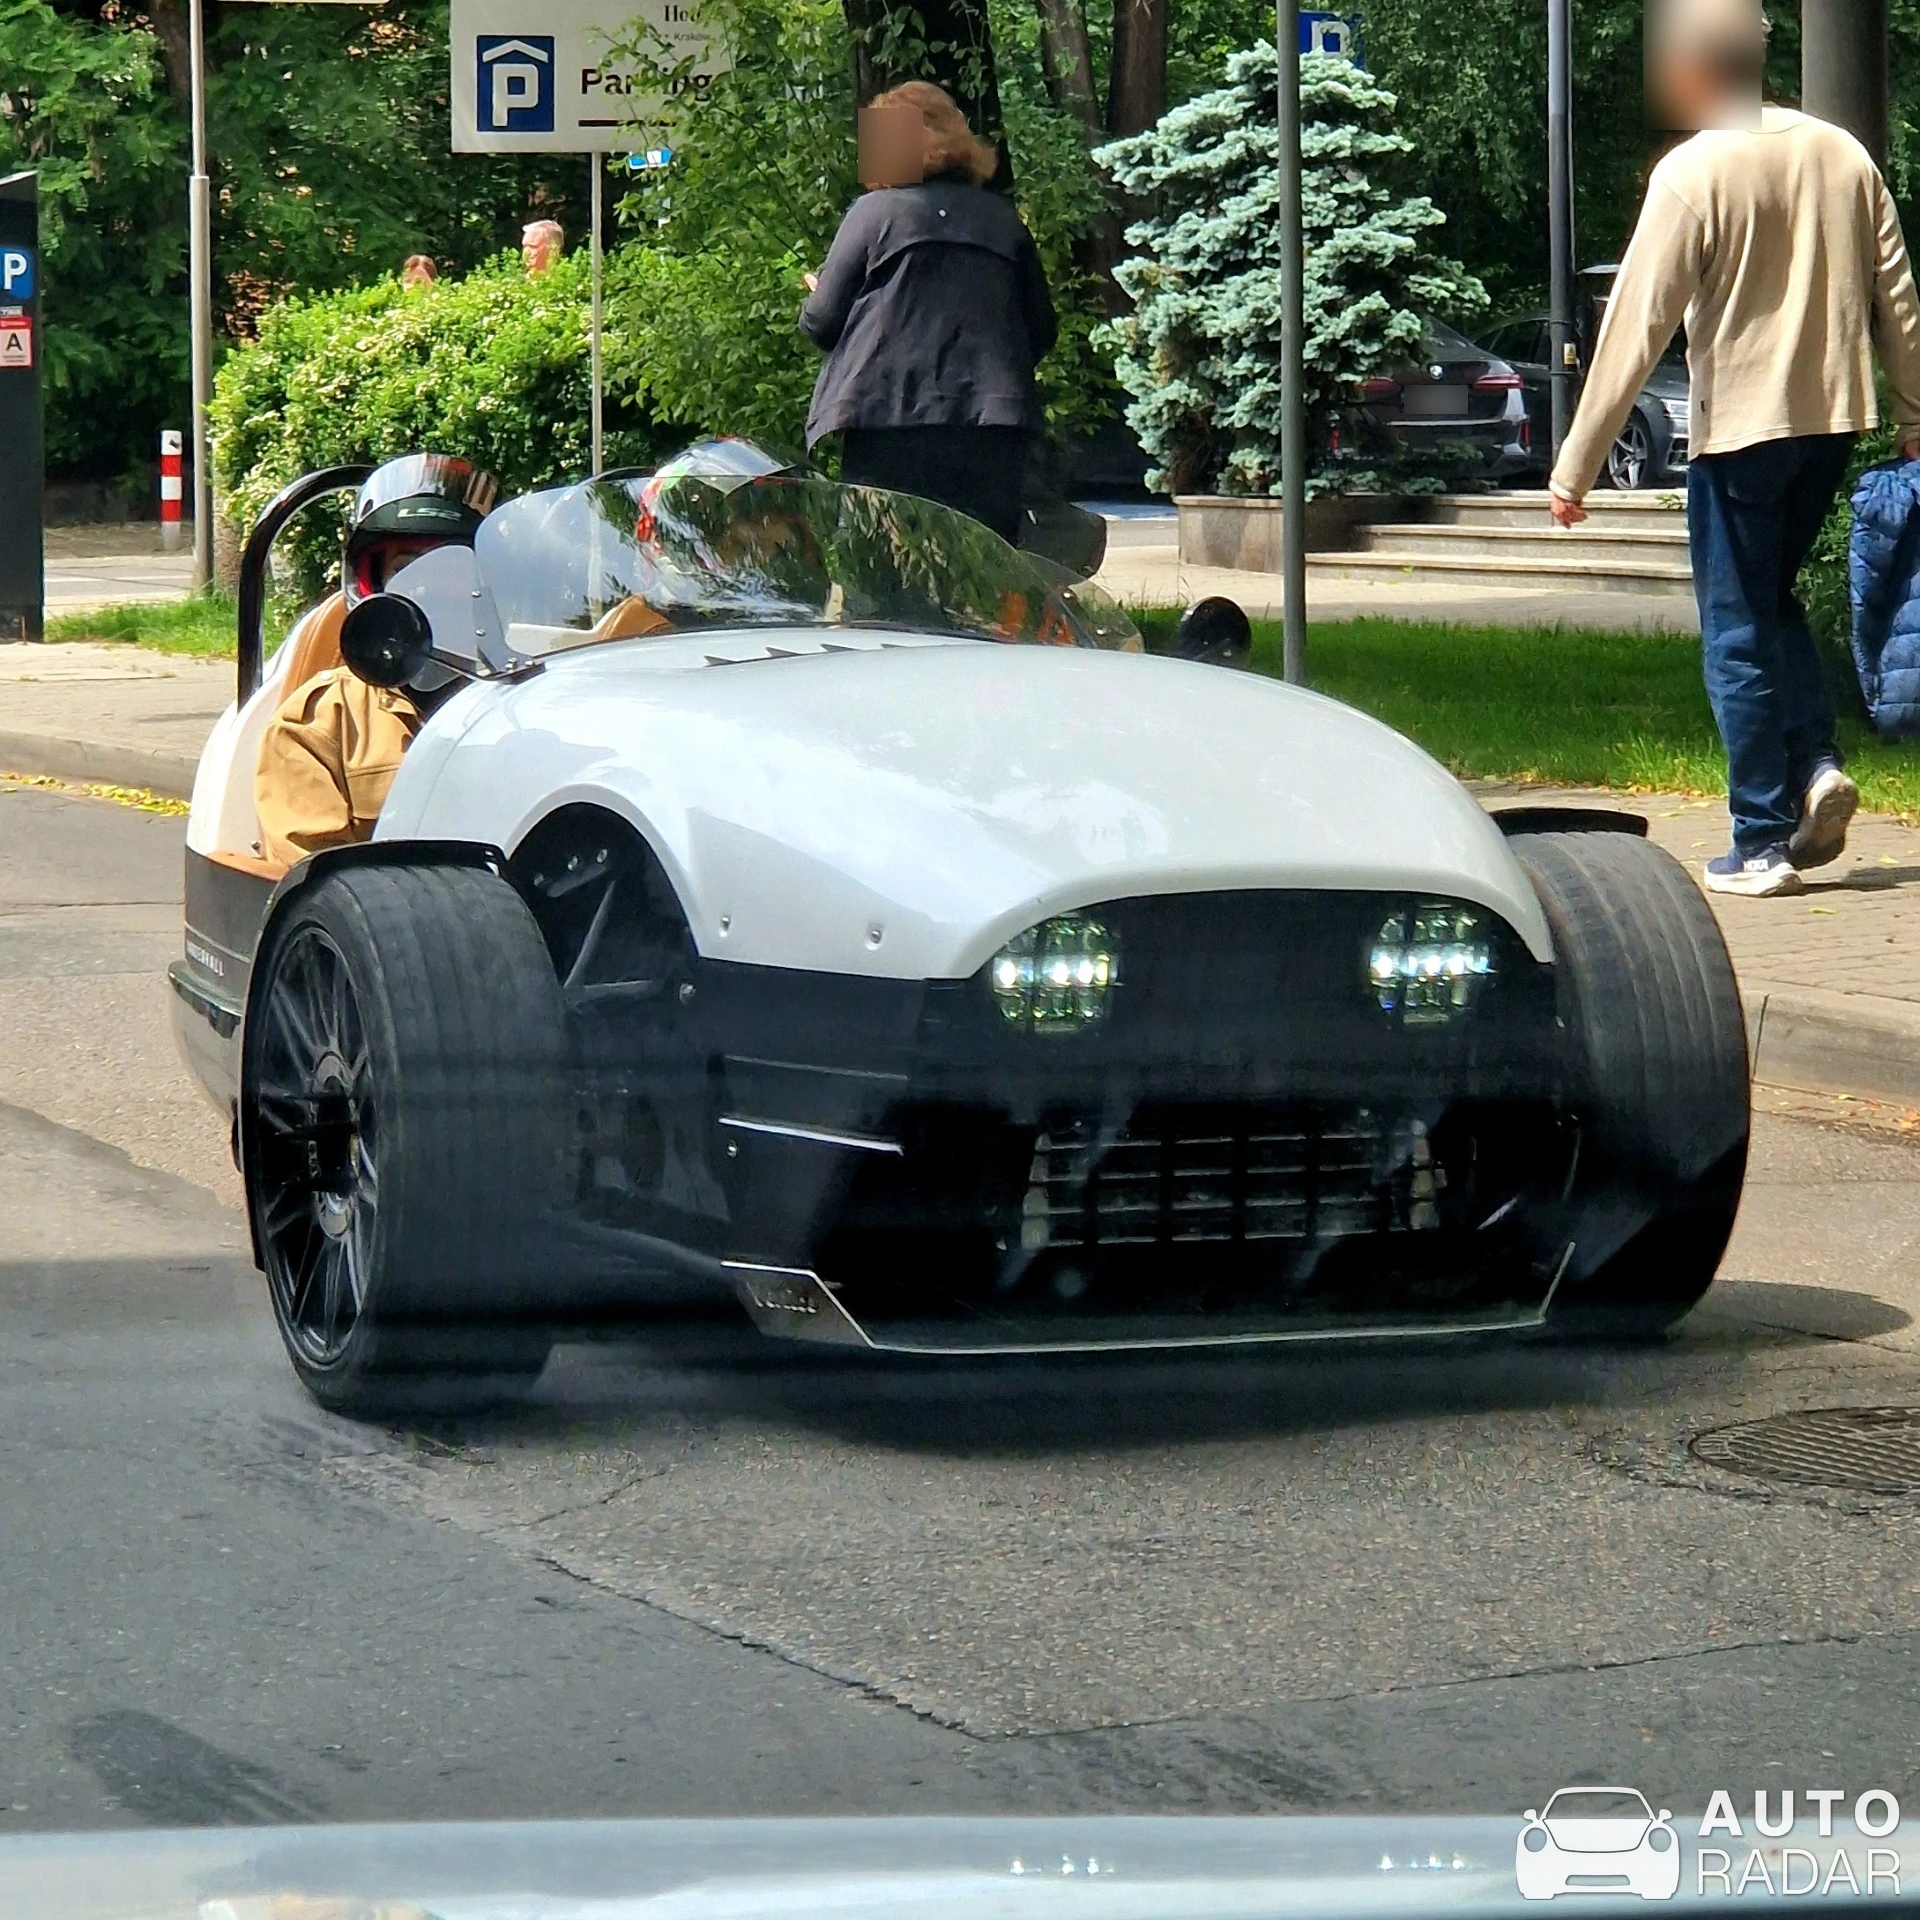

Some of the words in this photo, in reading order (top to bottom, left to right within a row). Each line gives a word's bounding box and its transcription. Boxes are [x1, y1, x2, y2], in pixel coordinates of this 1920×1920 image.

[492, 63, 539, 127] P
[3, 253, 27, 290] P
[6, 332, 23, 352] A
